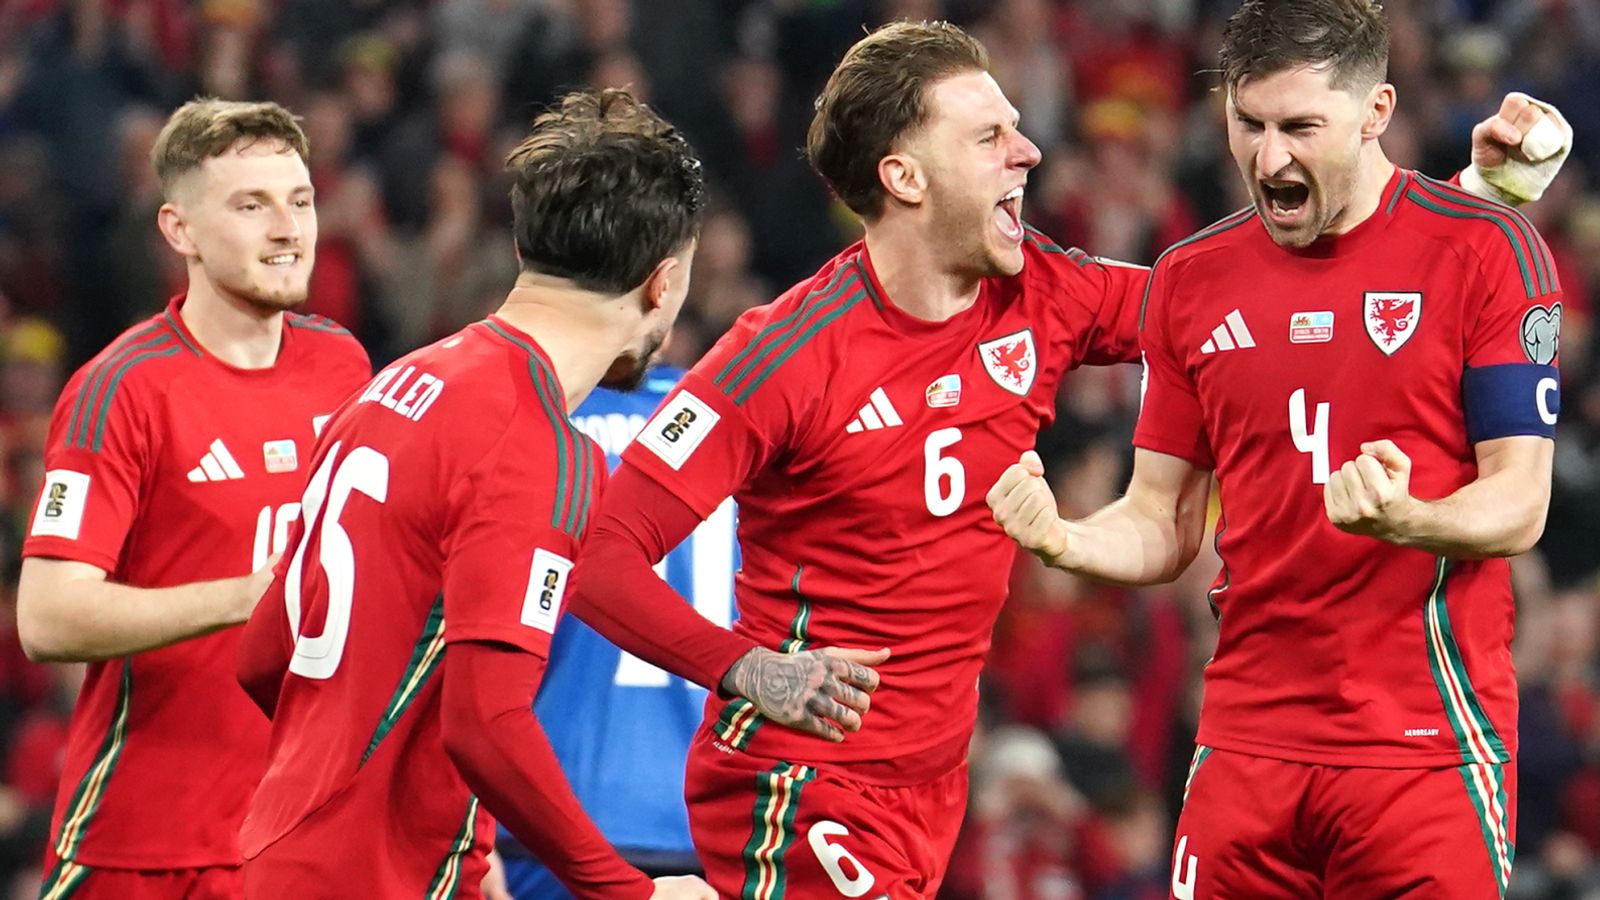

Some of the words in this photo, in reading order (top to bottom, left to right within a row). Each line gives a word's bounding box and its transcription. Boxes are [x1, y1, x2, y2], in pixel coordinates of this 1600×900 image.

[1289, 388, 1330, 484] 4
[1536, 377, 1558, 425] C
[924, 427, 966, 517] 6
[284, 440, 389, 680] 16
[807, 820, 875, 898] 6
[1172, 835, 1198, 900] 4
